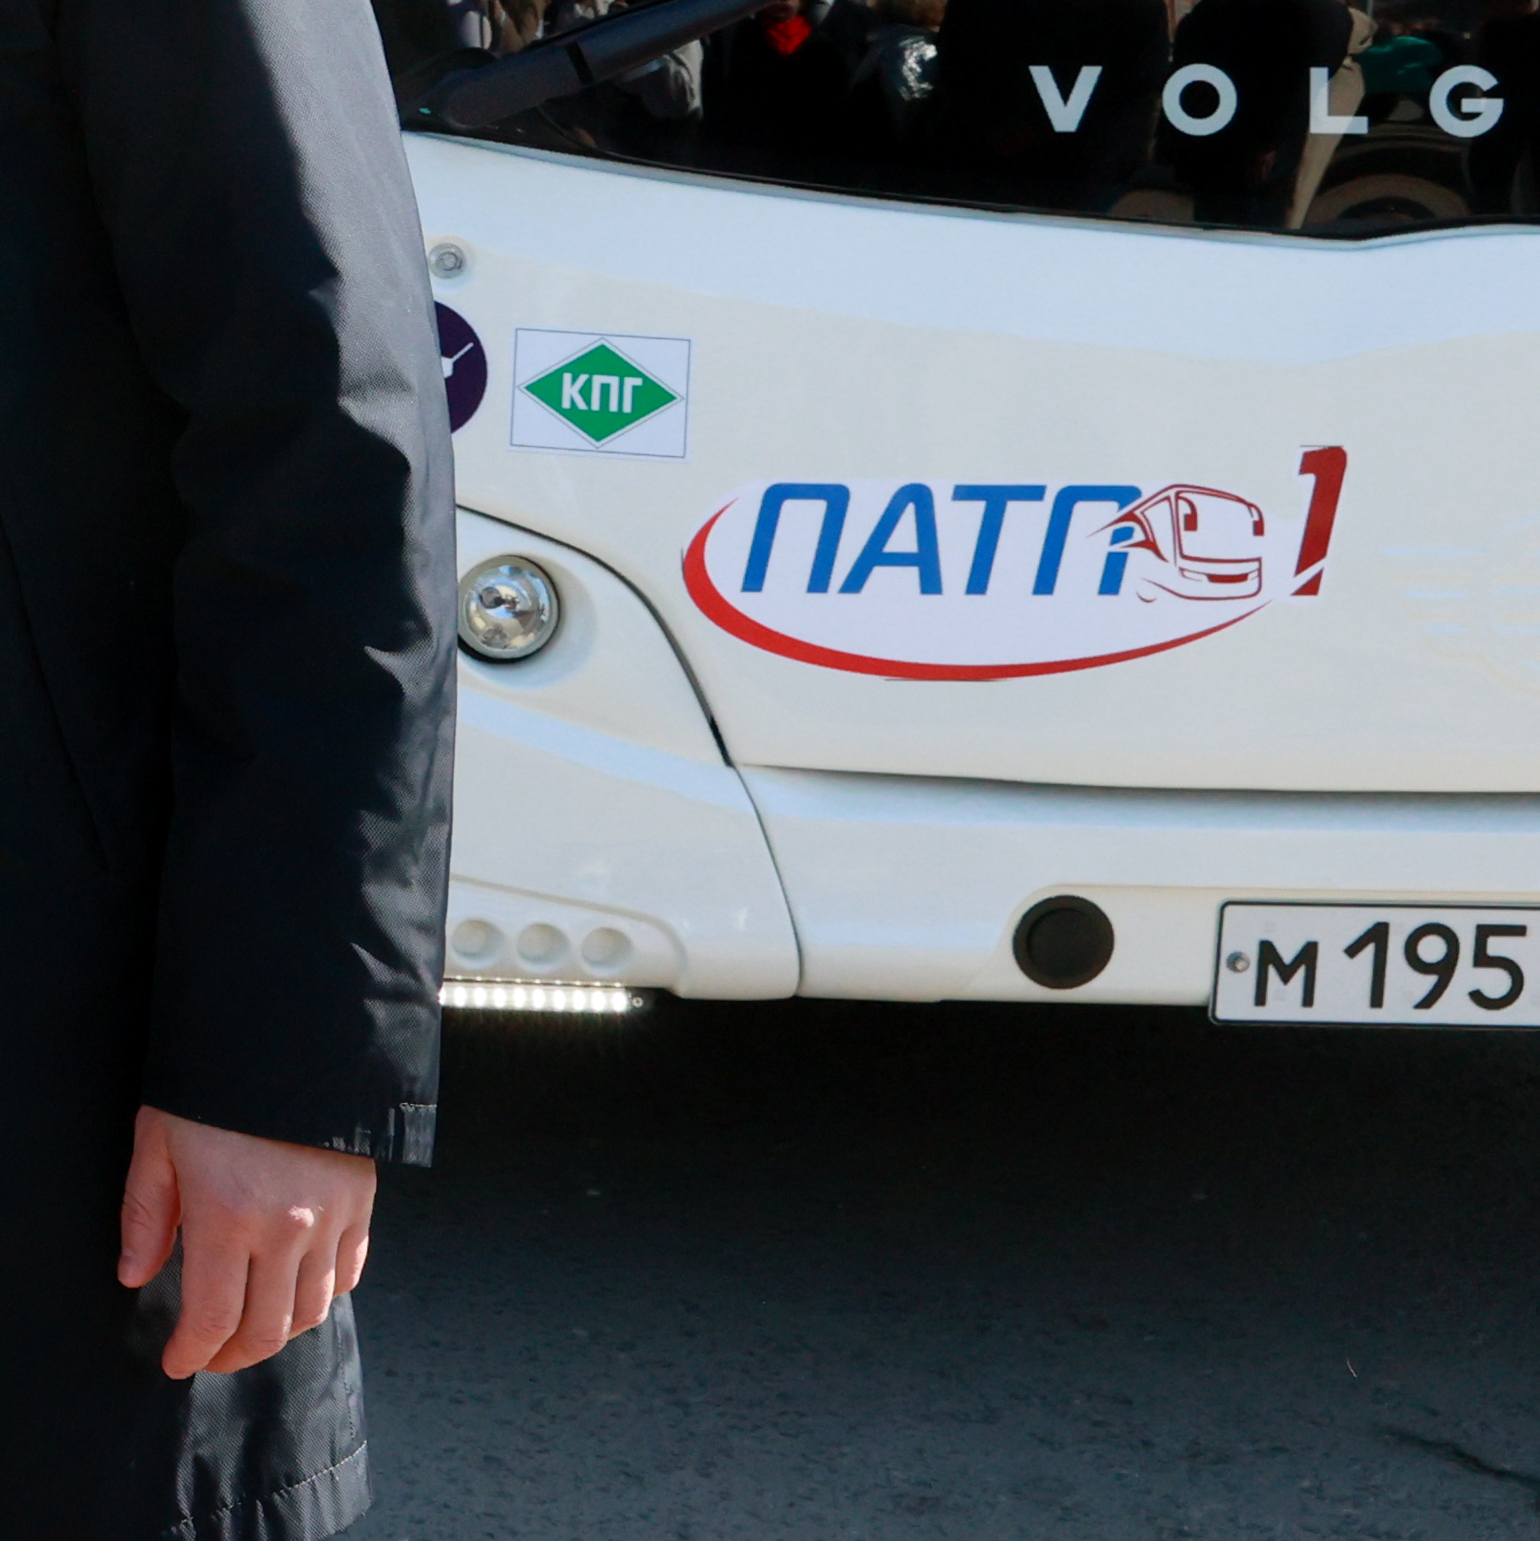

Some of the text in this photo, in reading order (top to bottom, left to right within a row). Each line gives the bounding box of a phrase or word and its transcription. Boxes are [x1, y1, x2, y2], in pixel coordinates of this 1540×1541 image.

[1028, 63, 1504, 138] VOLG
[561, 372, 643, 413] КПГ
[740, 446, 1348, 596] ПАТП 1
[1253, 921, 1527, 1011] М 195
